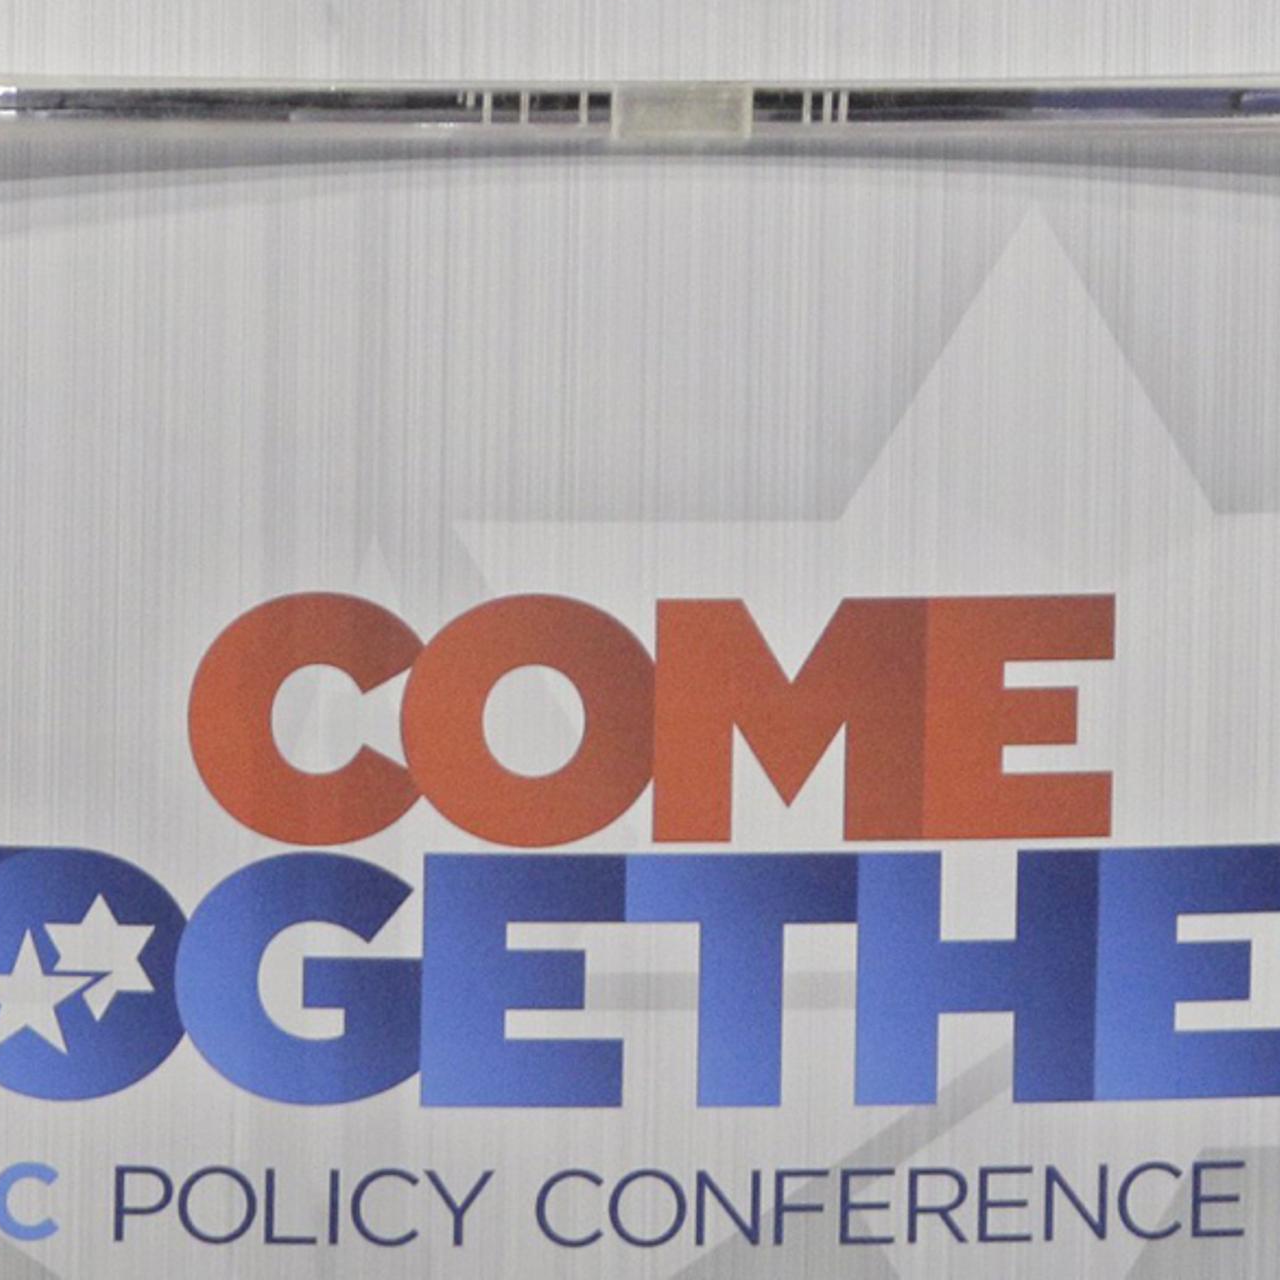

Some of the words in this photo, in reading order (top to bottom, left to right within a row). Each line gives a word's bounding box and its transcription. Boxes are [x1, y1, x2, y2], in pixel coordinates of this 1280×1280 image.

[187, 592, 1115, 848] COME
[112, 1165, 495, 1248] POLICY
[534, 1159, 1248, 1250] CONFERENCE
